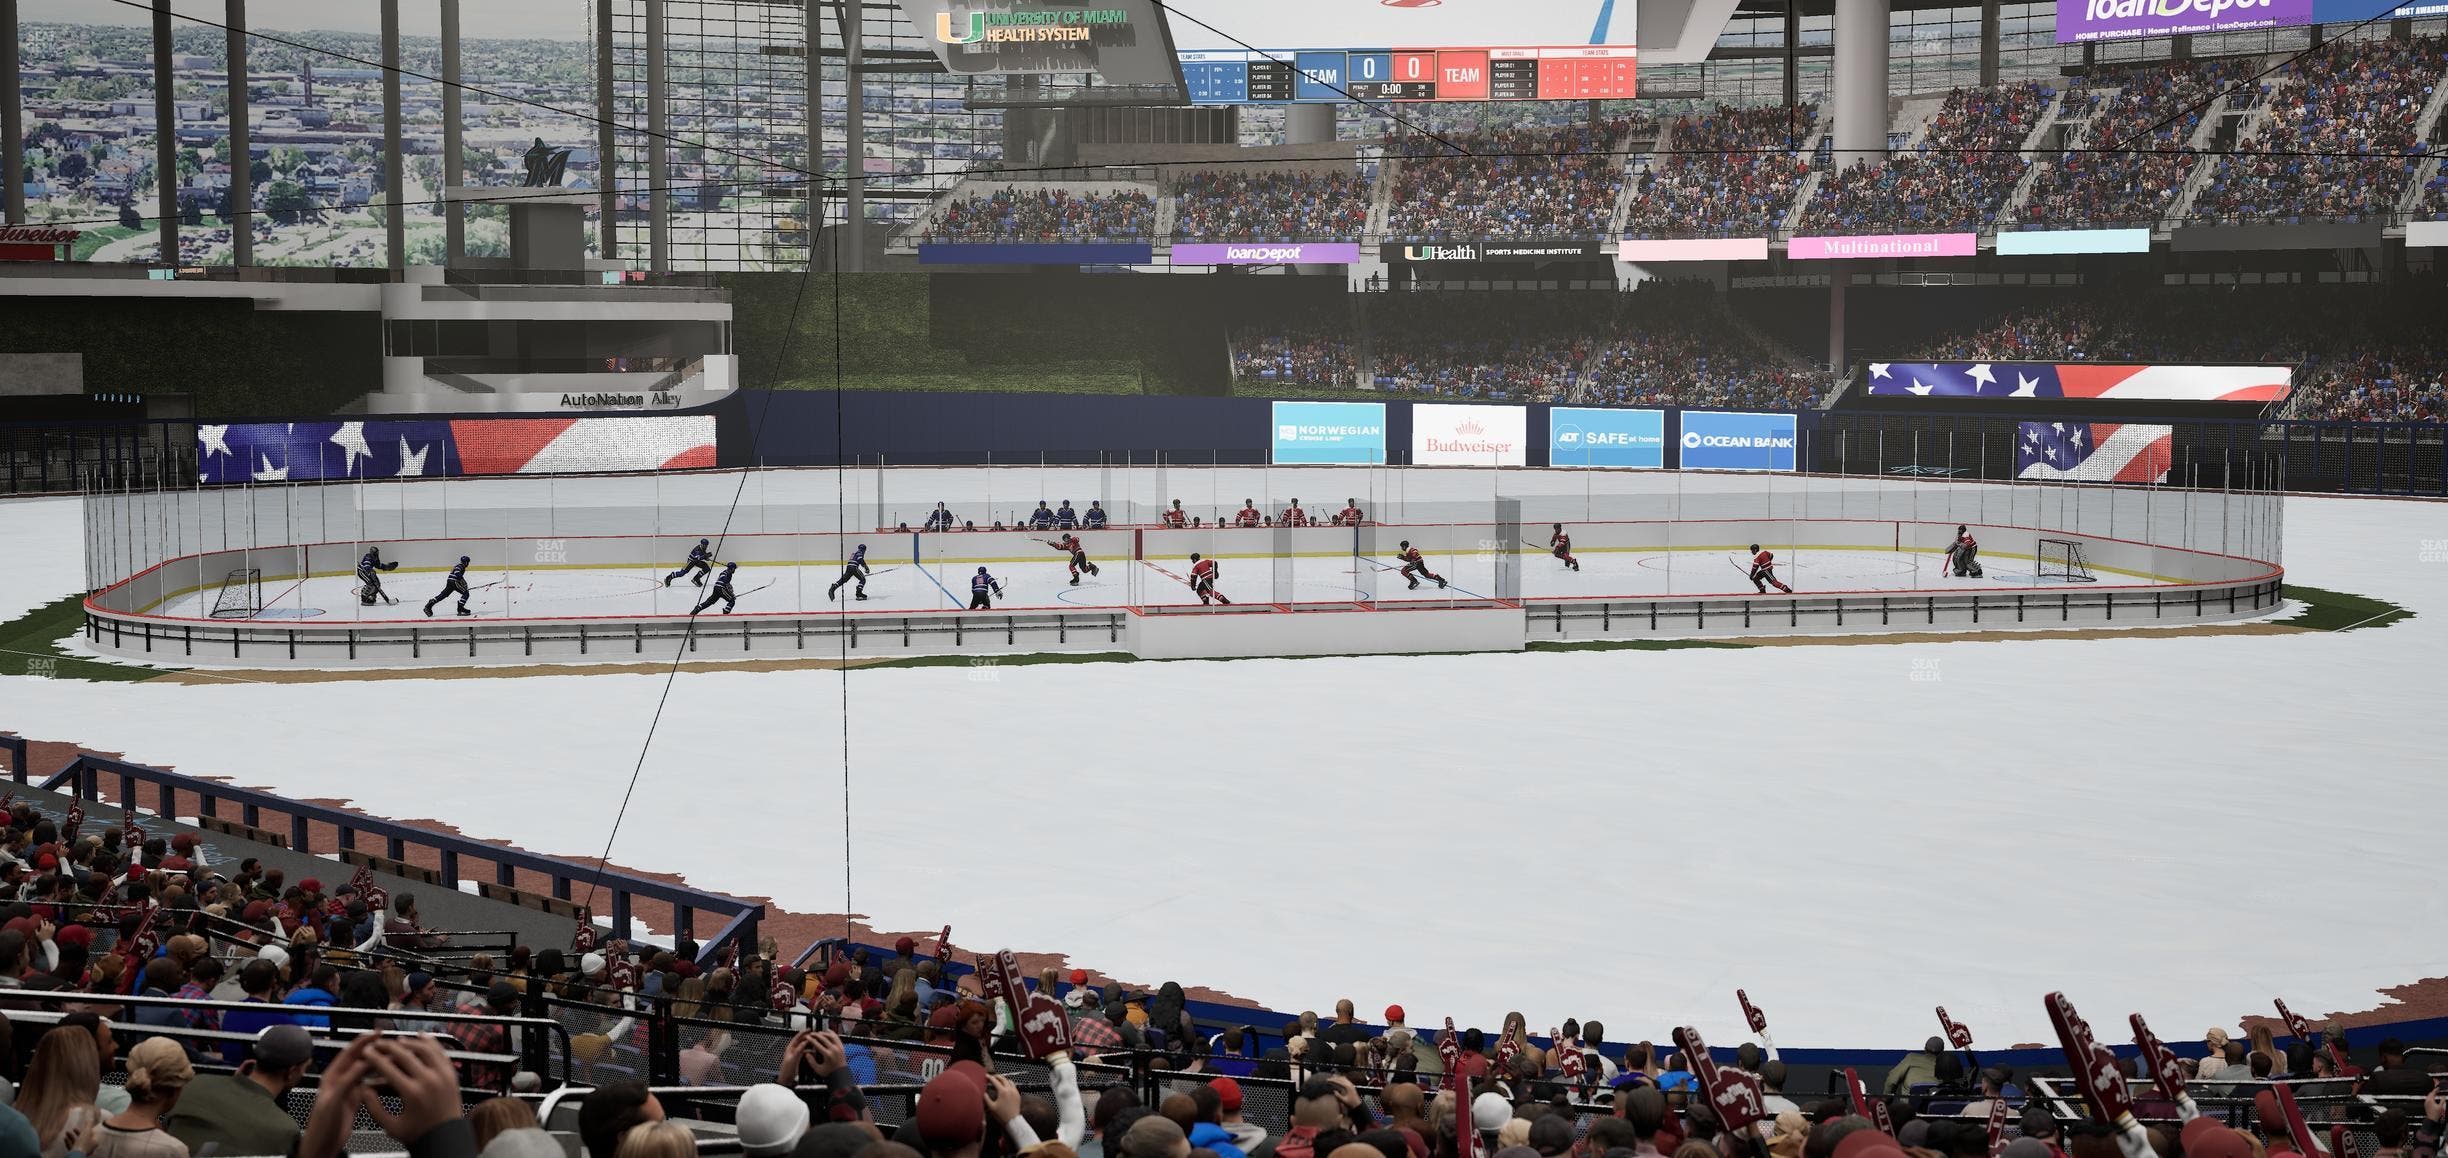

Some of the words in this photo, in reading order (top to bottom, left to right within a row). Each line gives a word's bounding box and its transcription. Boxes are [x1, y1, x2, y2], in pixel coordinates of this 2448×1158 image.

[986, 11, 1063, 26] UNIVERSITY
[1063, 10, 1082, 25] OF
[1083, 10, 1127, 24] MIAMI
[2086, 0, 2271, 21] loanDep
[987, 28, 1036, 42] HEALTH
[1038, 27, 1089, 41] SYSTEM
[2076, 32, 2098, 40] HOME
[2100, 28, 2142, 38] PURCHASE
[2148, 27, 2170, 35] Home
[2172, 24, 2210, 33] Refinance
[1363, 57, 1375, 79] 0
[1408, 57, 1420, 79] 0
[1445, 68, 1479, 83] TEAM
[1303, 69, 1337, 84] TEAM
[1381, 83, 1401, 94] 0:00
[1226, 246, 1301, 261] loanDepot
[1824, 239, 1939, 255] Multinational
[560, 393, 644, 406] AutoNation
[1299, 425, 1380, 436] NORWEGIAN
[1558, 432, 1580, 443] ADT
[1426, 439, 1512, 453] Budweiser
[1586, 432, 1629, 445] SAFE
[1629, 434, 1637, 443] at
[1638, 434, 1661, 443] home
[1703, 436, 1751, 448] OCEAN
[1754, 437, 1793, 449] BANK
